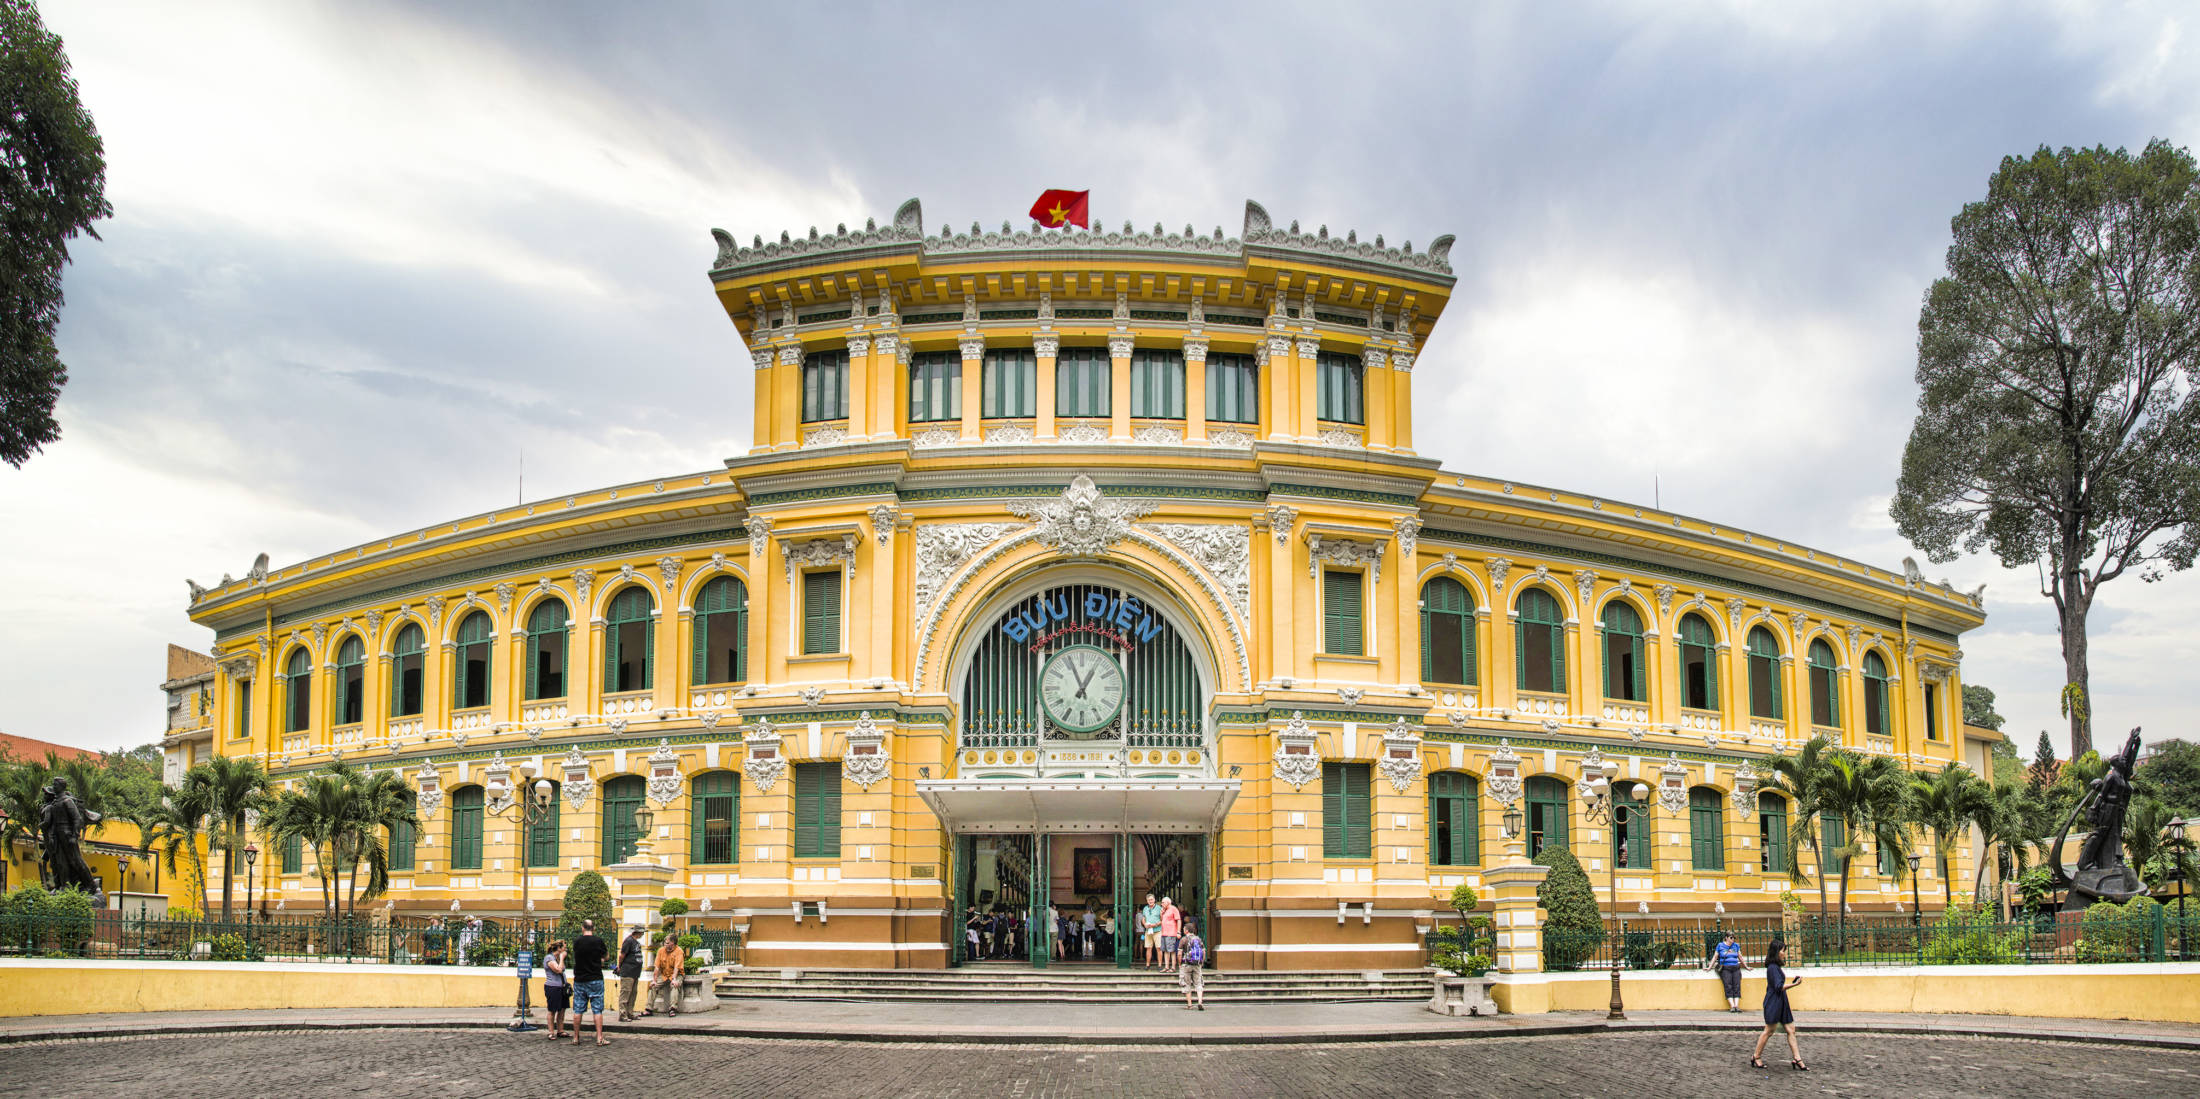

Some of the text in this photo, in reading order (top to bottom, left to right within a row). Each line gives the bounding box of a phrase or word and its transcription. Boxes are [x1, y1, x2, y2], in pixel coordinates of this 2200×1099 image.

[1084, 592, 1163, 643] ĐIỆN
[1096, 628, 1116, 639] CHÍ
[1112, 635, 1135, 653] MINH
